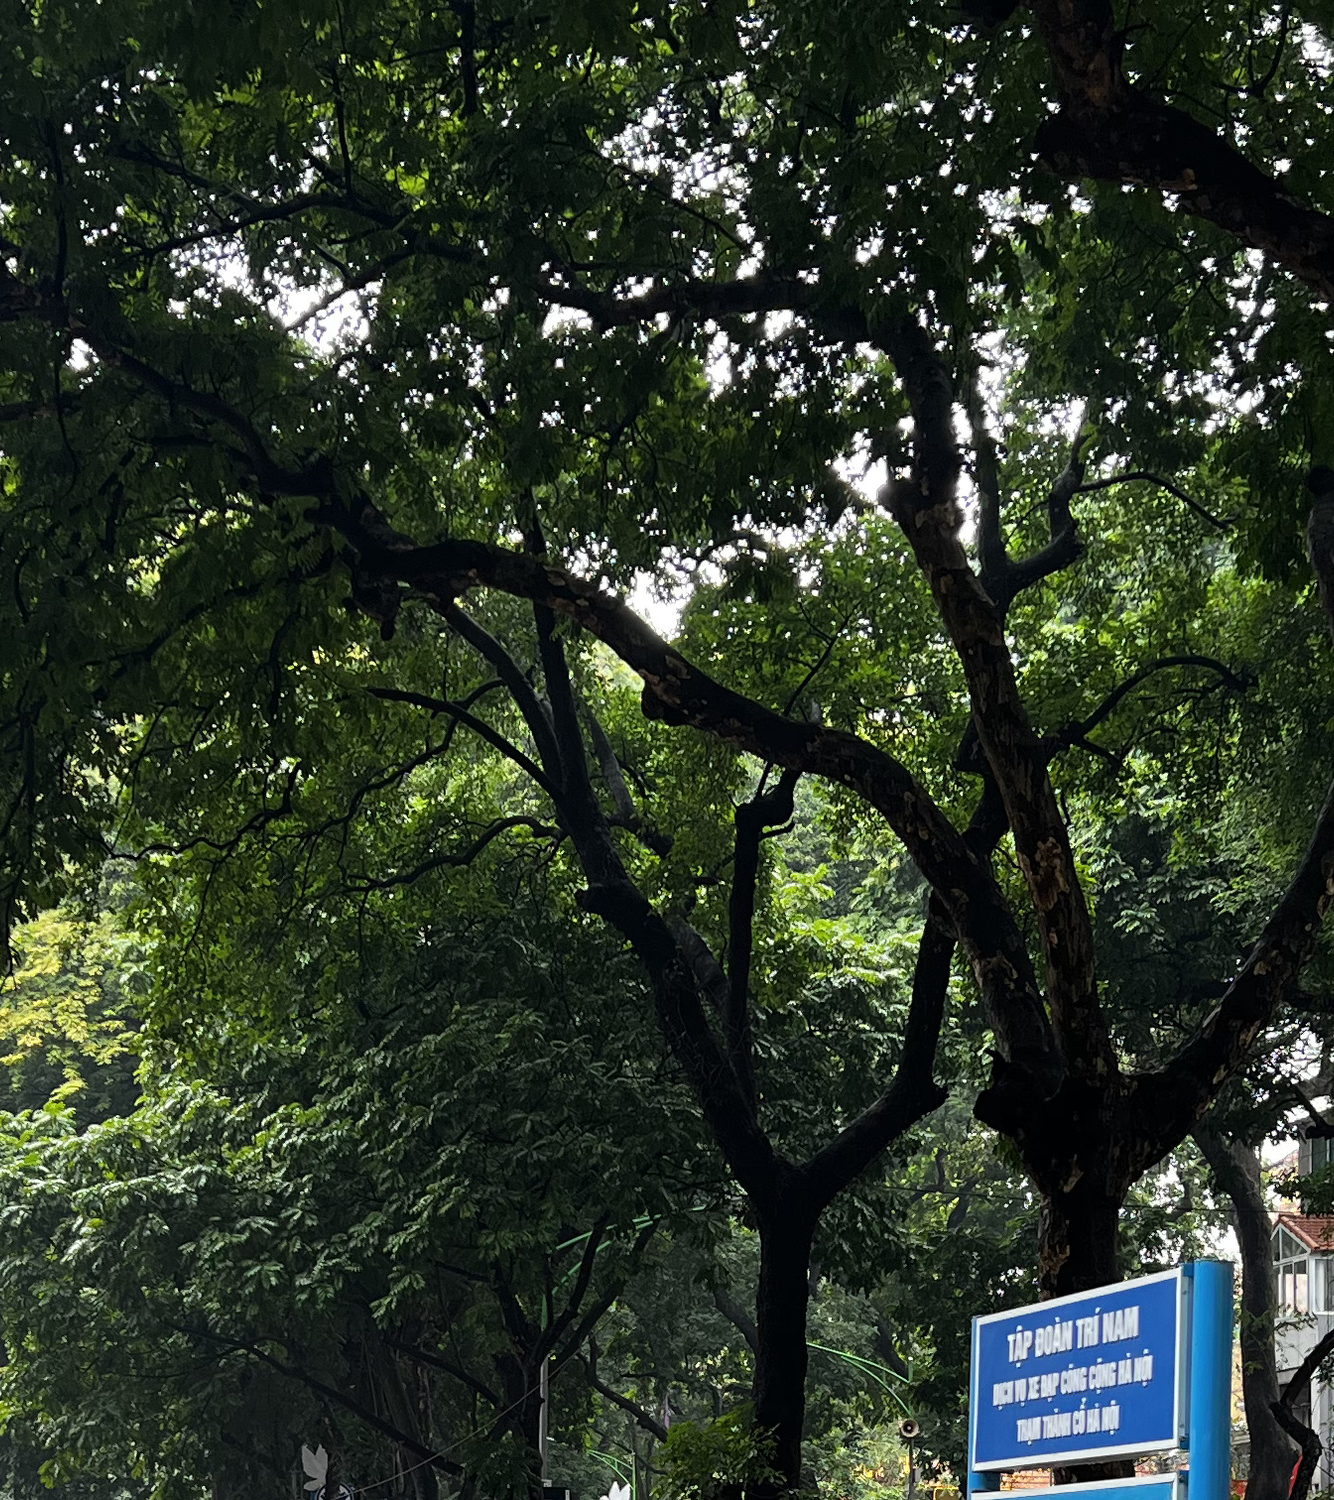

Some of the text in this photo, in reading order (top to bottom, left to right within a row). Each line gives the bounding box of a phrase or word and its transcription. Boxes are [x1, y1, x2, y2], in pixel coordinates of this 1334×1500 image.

[1008, 1305, 1140, 1368] TẬP ĐOÀN TRÍ NAM
[992, 1381, 1014, 1411] DỊCH
[1014, 1379, 1027, 1407] VỤ
[1028, 1376, 1040, 1401] XE
[1060, 1363, 1088, 1395] CÔNG
[1089, 1357, 1117, 1395] CỘNG
[1118, 1352, 1132, 1386] HÀ
[1133, 1348, 1154, 1387] NỘI
[1042, 1408, 1072, 1439] THÀNH
[1087, 1403, 1101, 1433] HÀ
[1101, 1399, 1121, 1436] NỘI
